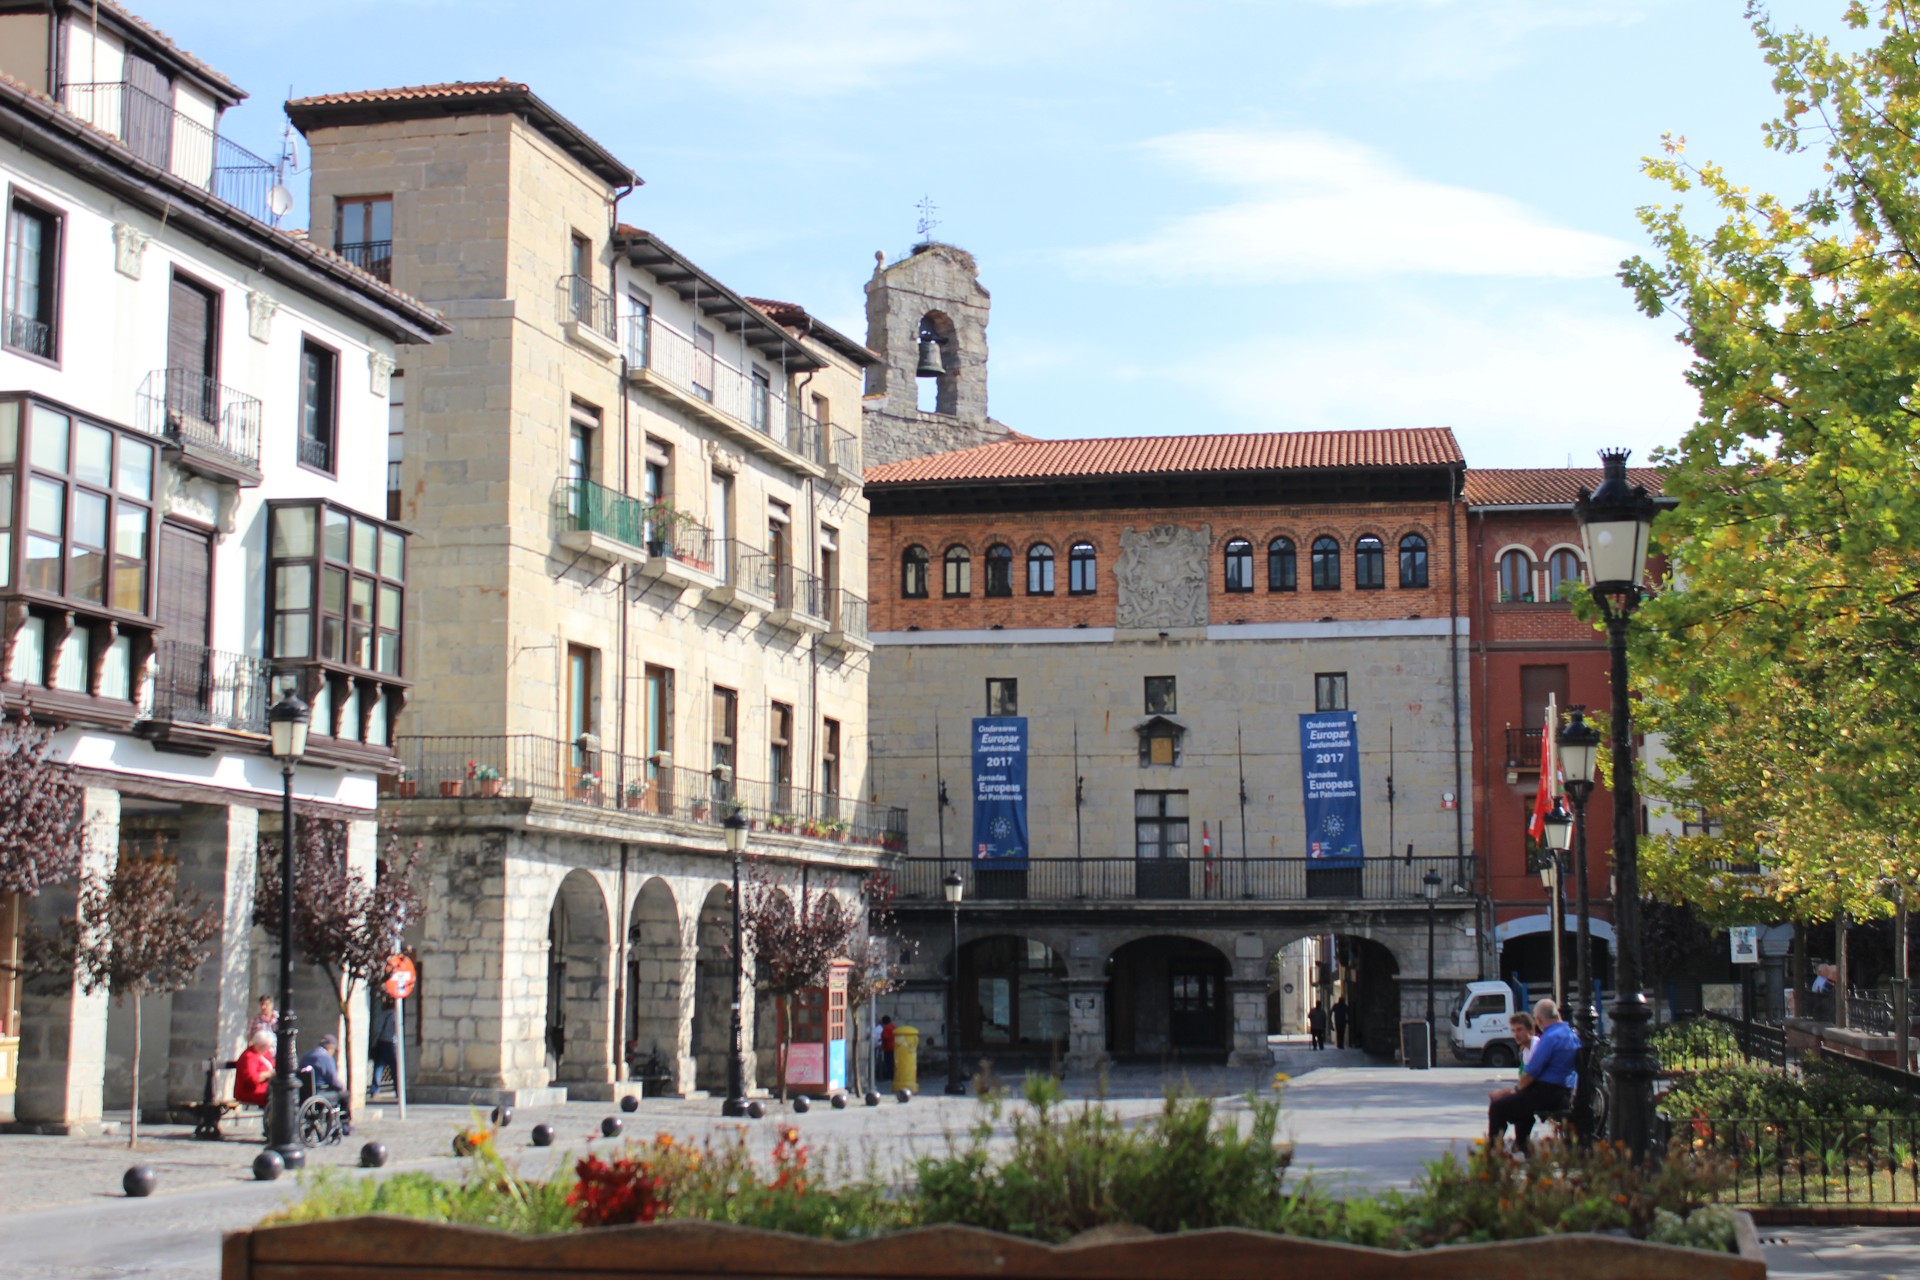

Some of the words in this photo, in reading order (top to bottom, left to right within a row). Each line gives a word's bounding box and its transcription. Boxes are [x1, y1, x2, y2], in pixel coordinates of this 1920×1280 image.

[982, 734, 1019, 744] Europar
[1310, 730, 1349, 740] Europar
[987, 757, 1012, 767] 2017
[1316, 753, 1344, 763] 2017
[979, 782, 1020, 794] Europeas
[1310, 780, 1353, 792] Europeas
